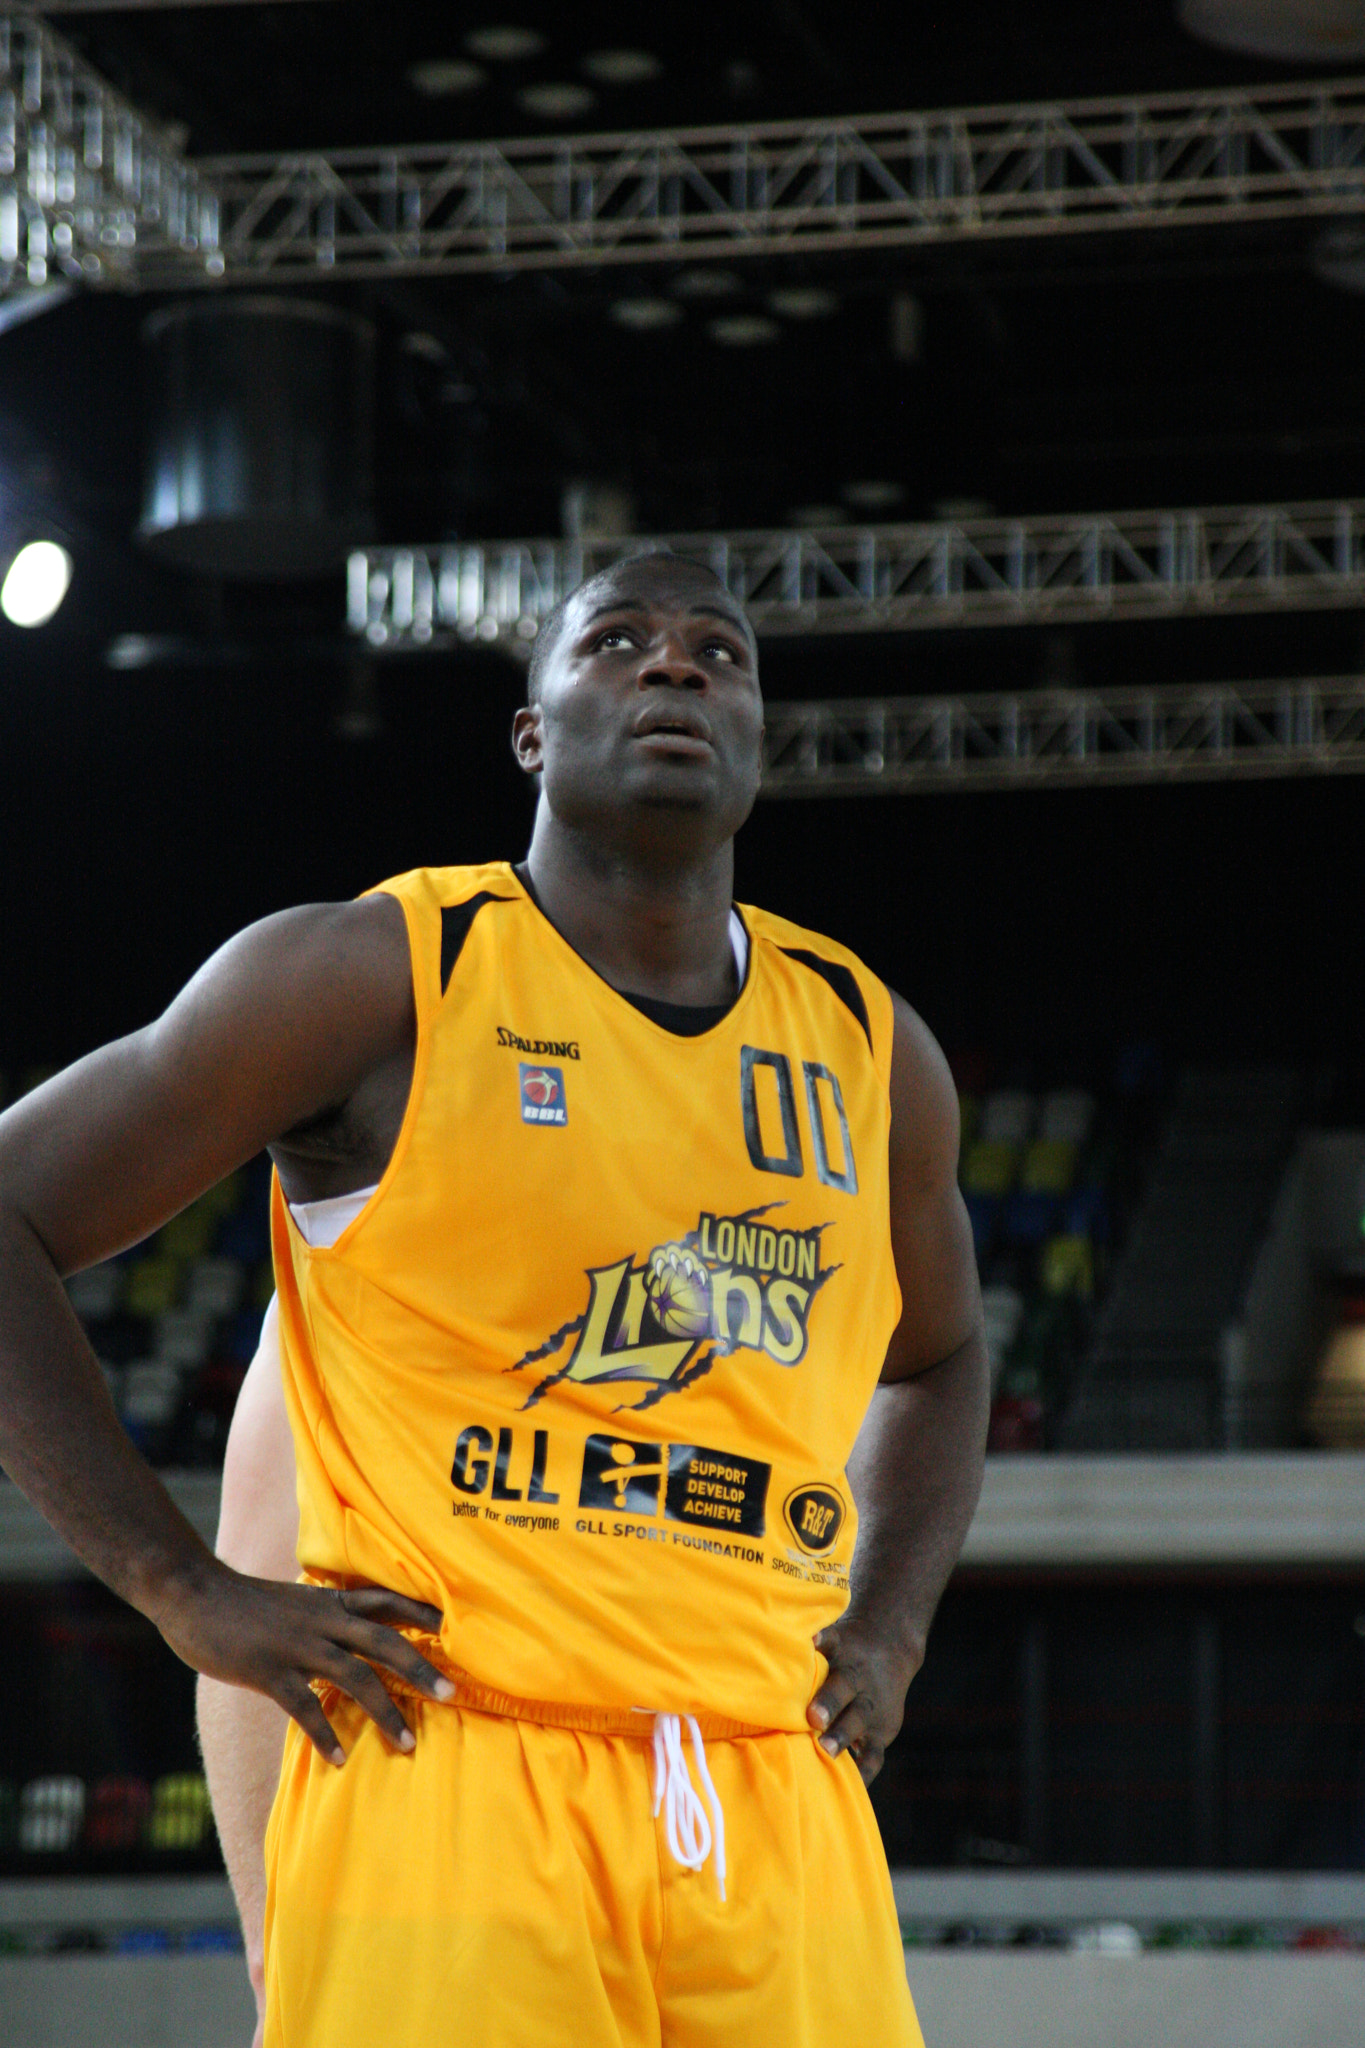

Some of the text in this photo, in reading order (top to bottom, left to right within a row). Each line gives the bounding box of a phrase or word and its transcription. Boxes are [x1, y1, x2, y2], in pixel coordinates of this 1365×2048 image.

[497, 1026, 581, 1060] SPALDING
[523, 1106, 566, 1122] BBL
[701, 1215, 818, 1281] LONDON
[450, 1425, 560, 1505] GLL
[690, 1459, 748, 1486] SUPPORT
[687, 1479, 746, 1503] DEVELOP
[453, 1500, 560, 1533] better for everyone
[683, 1499, 742, 1523] ACHIEVE
[576, 1519, 608, 1536] GLL
[613, 1523, 669, 1542] SPORT
[673, 1532, 765, 1565] FOUNDATION
